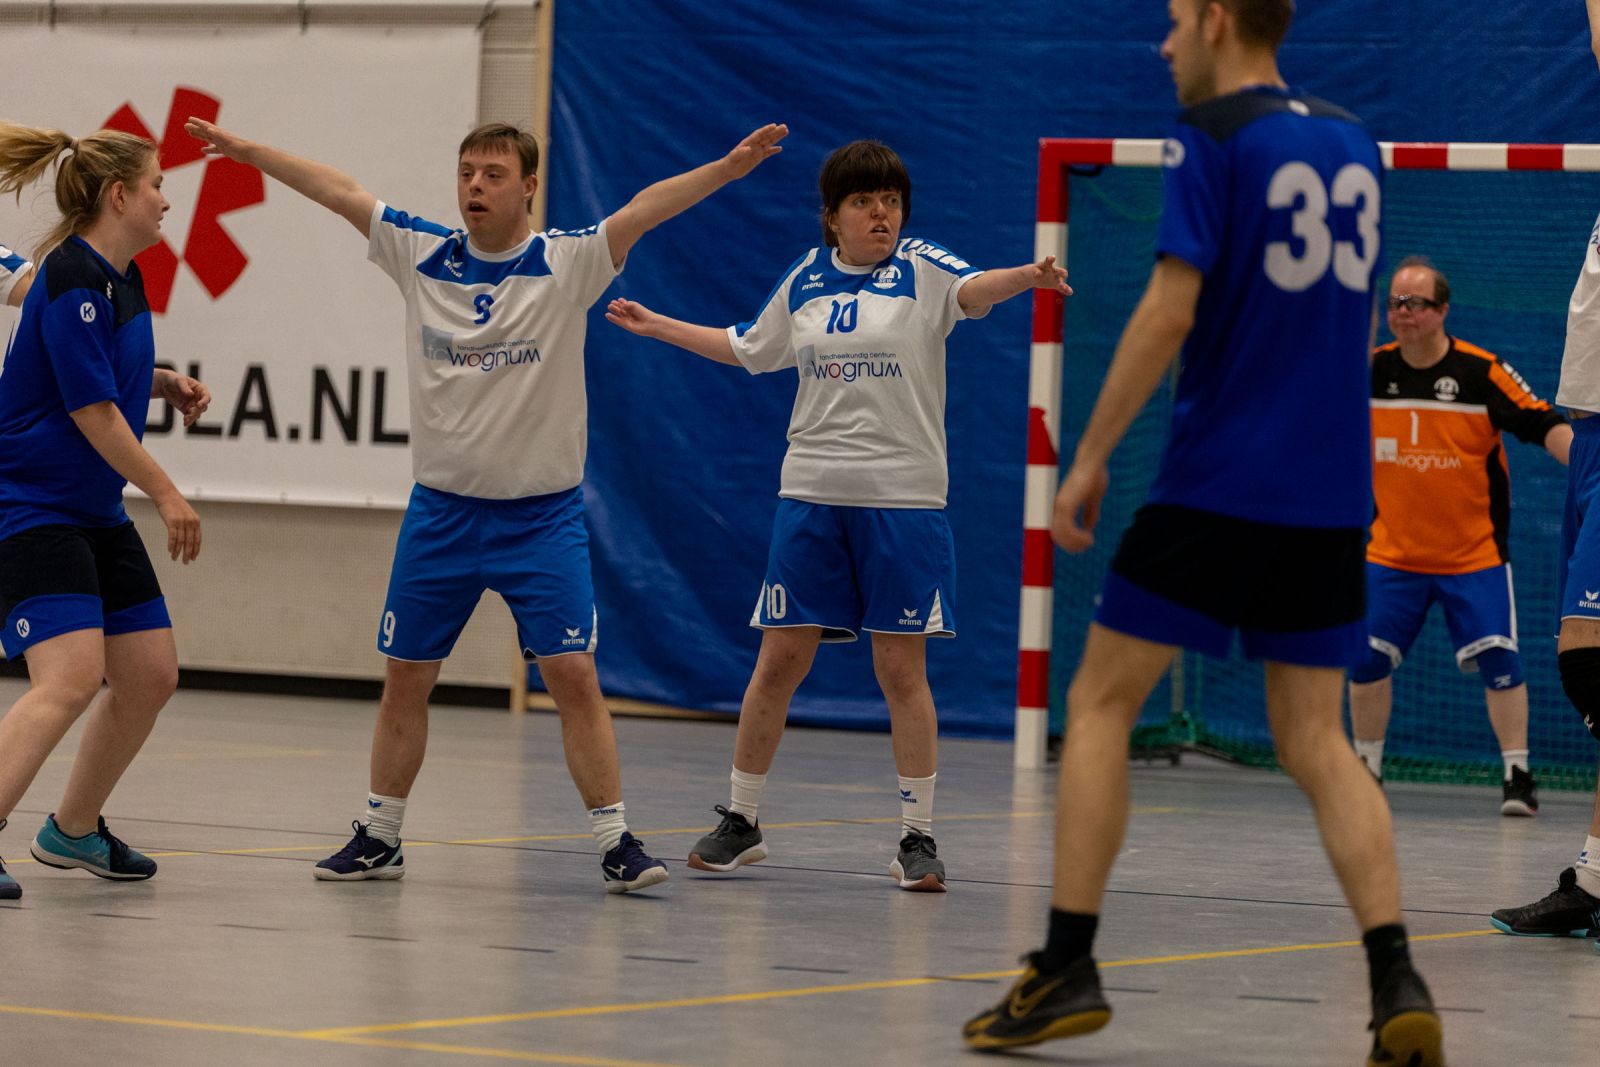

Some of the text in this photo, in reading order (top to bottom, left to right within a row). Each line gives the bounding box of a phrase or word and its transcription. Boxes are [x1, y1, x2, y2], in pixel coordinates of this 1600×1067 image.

[1264, 160, 1381, 293] 33
[802, 281, 825, 291] erima
[473, 293, 495, 325] 9
[826, 298, 858, 334] 10
[819, 351, 897, 361] tandheelkundig centrum
[766, 583, 787, 620] 10
[383, 610, 396, 648] 9
[898, 617, 922, 626] erima
[562, 636, 585, 646] erima
